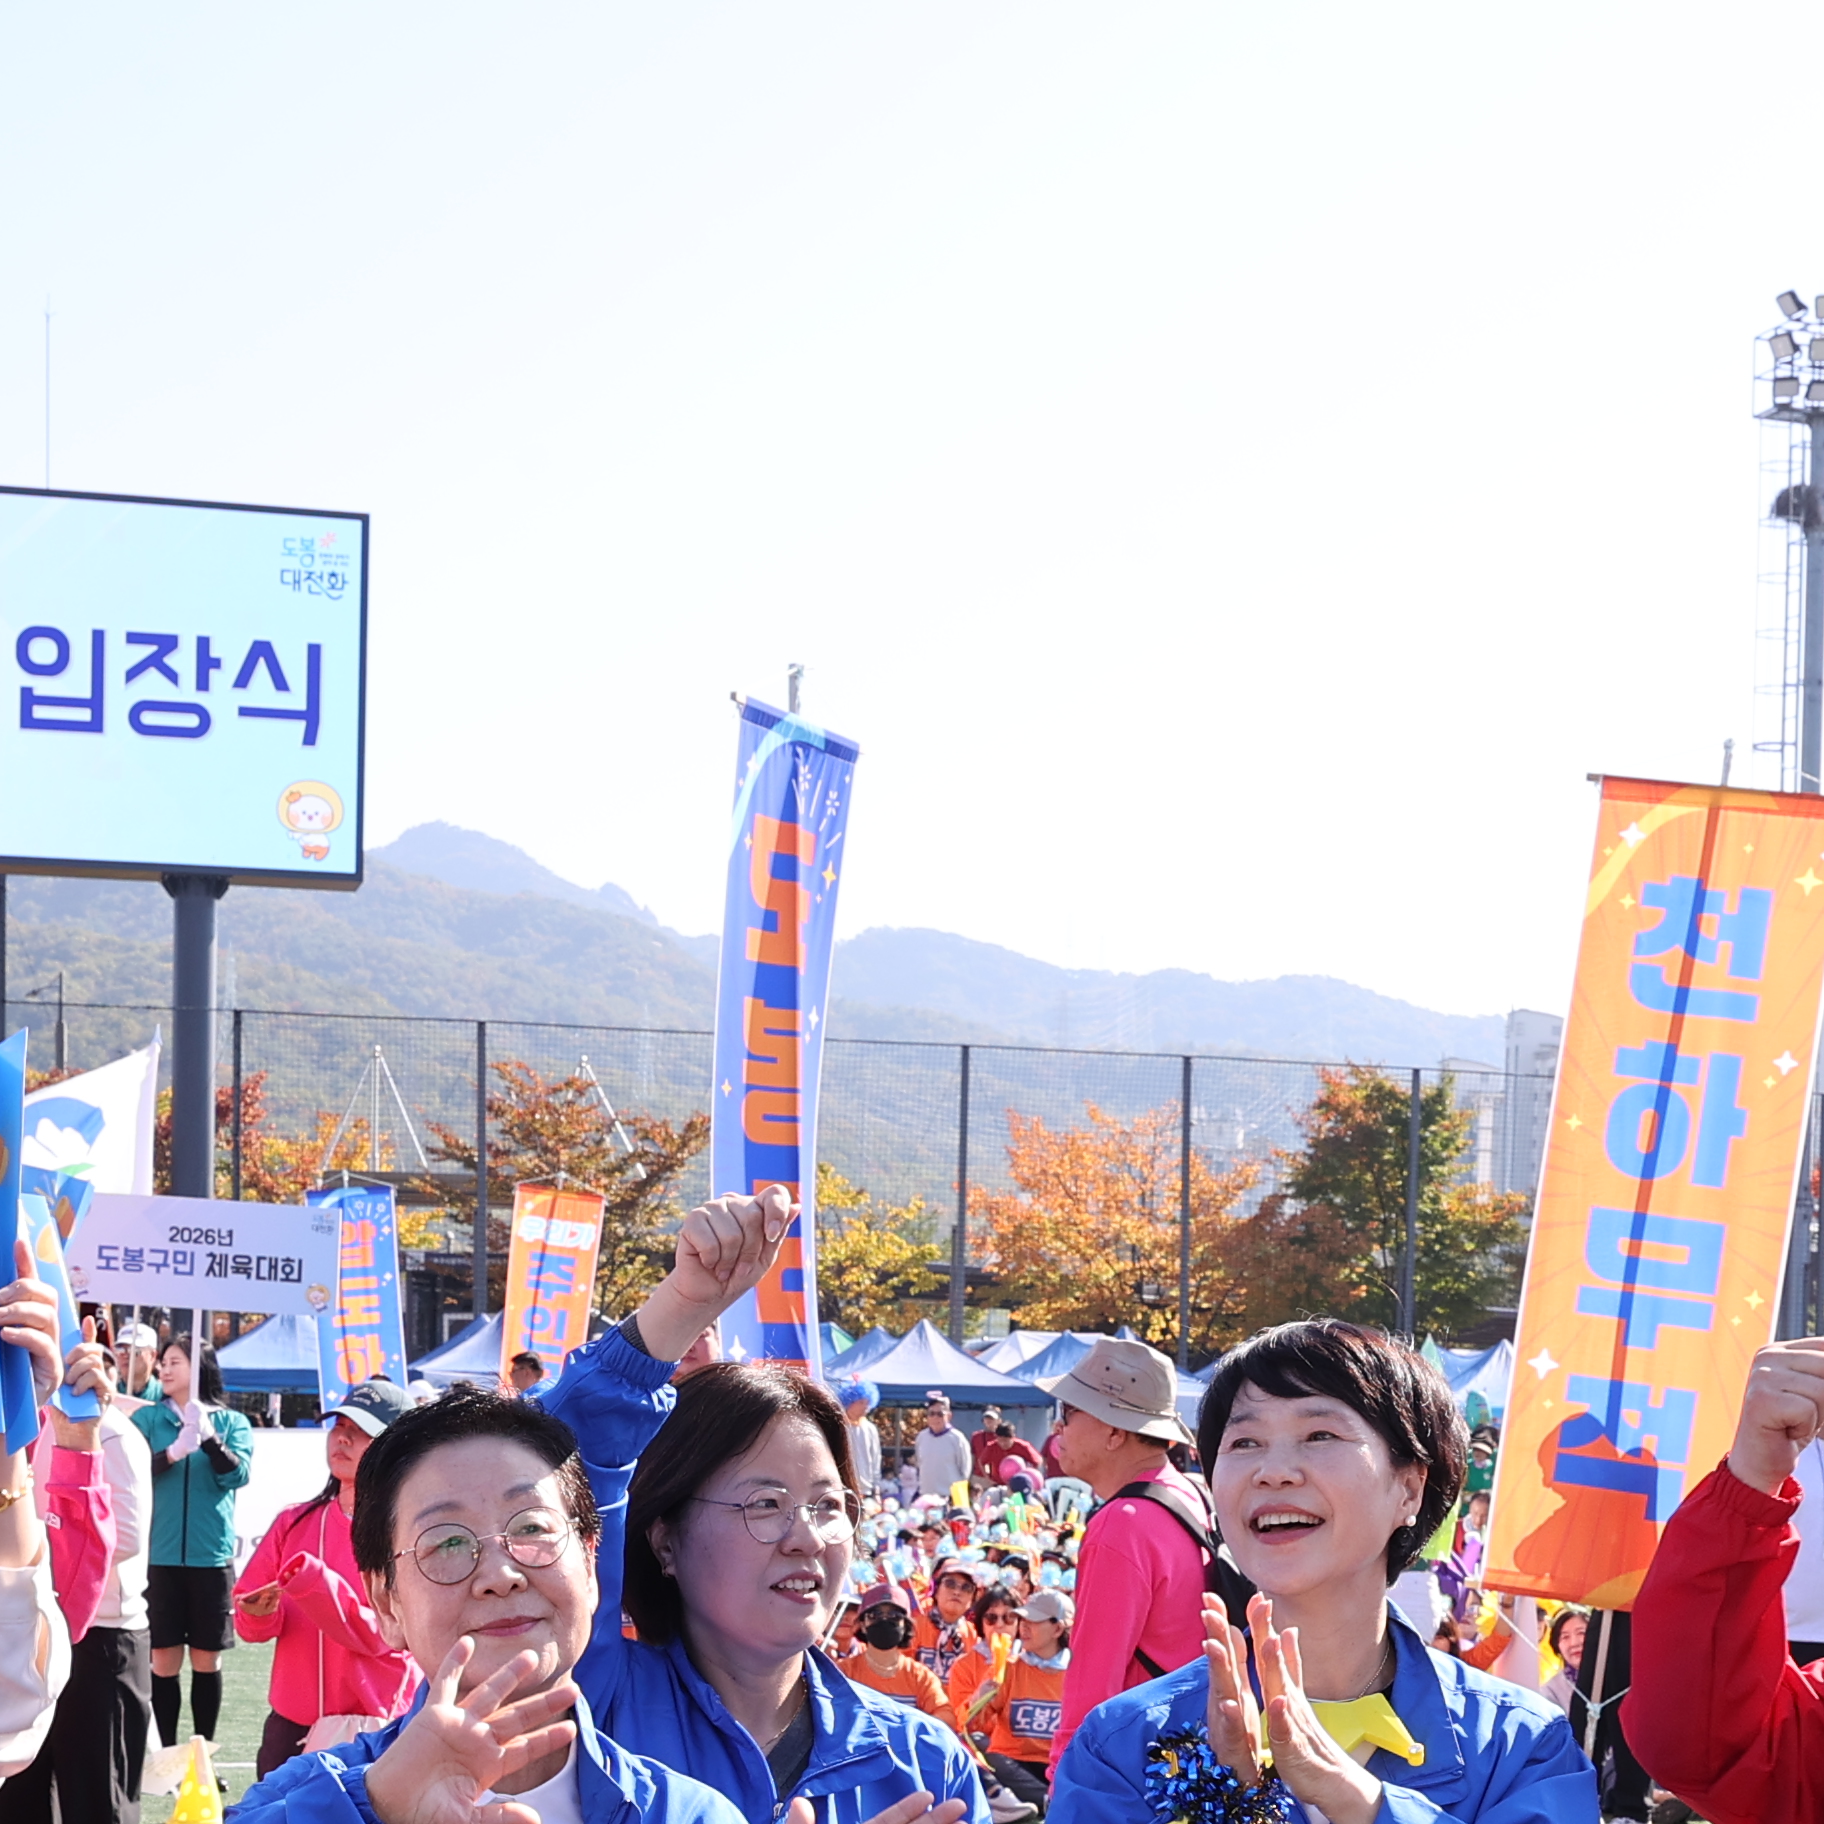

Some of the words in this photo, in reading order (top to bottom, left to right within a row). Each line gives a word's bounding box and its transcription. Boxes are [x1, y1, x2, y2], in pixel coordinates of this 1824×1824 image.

[281, 537, 315, 568] 도봉
[280, 569, 349, 601] 대전환
[15, 625, 322, 747] 입장식
[1554, 875, 1774, 1522] 천하무적
[168, 1226, 233, 1247] 2026년
[518, 1217, 596, 1249] 우리가
[96, 1245, 196, 1276] 도봉구민
[204, 1252, 303, 1283] 체육대회
